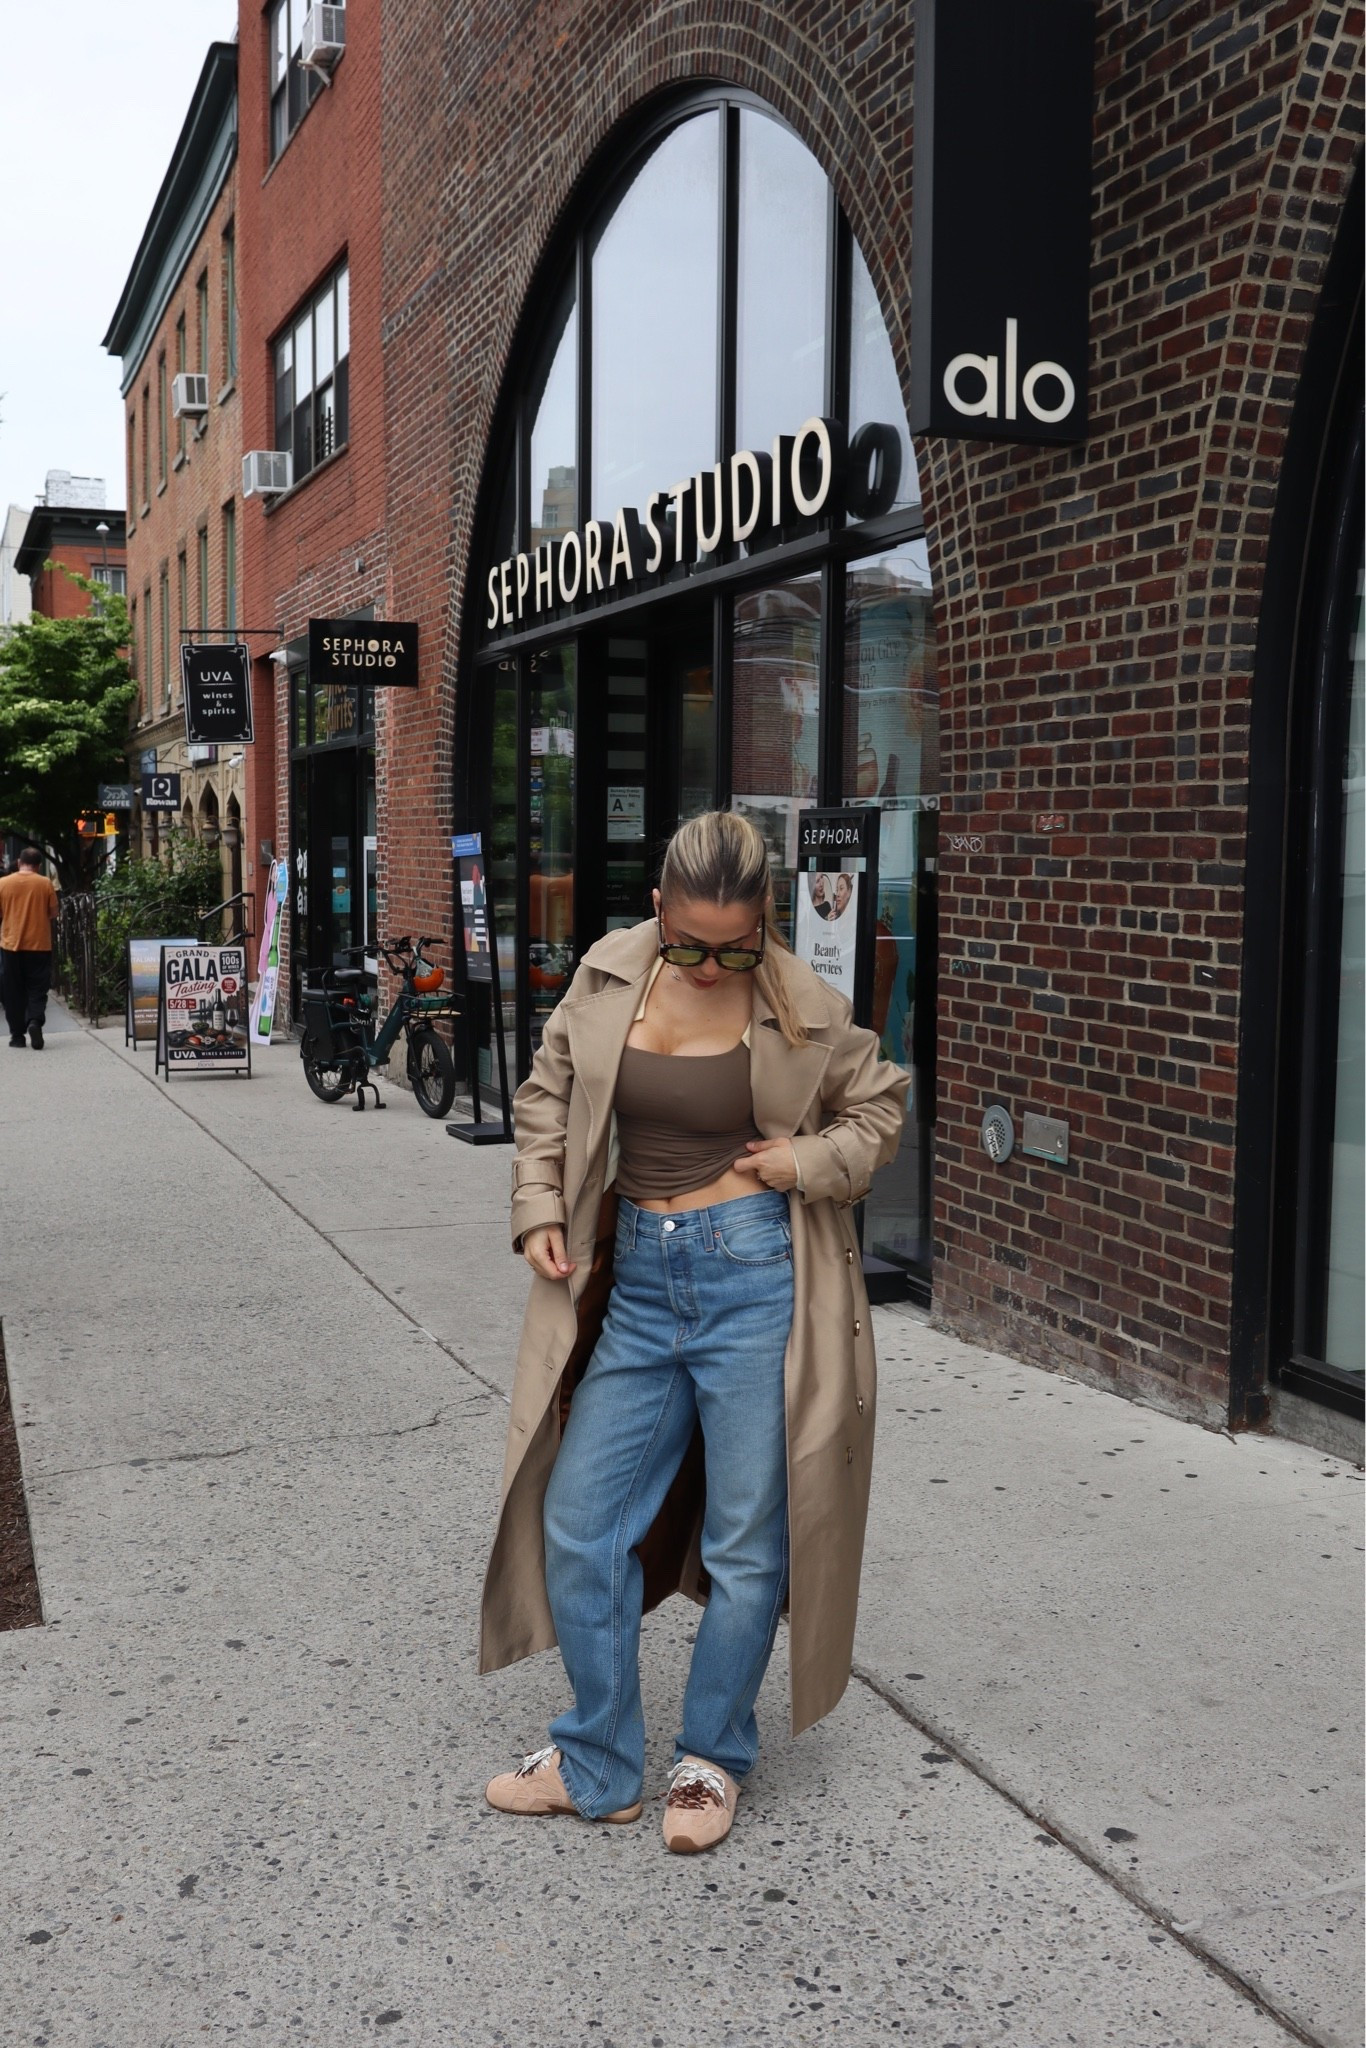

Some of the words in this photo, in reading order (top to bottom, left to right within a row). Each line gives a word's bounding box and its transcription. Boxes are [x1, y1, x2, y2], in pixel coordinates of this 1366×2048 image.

[943, 317, 1075, 423] alo
[487, 507, 634, 630] SEPHORA
[646, 417, 832, 573] STUDIO
[323, 638, 405, 653] SEPHORA
[332, 653, 396, 668] STUDIO
[200, 671, 233, 682] UVA
[202, 707, 236, 717] spirits
[146, 798, 177, 806] Rowan
[612, 798, 624, 812] A
[804, 828, 860, 845] SEPHORA
[175, 949, 210, 958] GRAND
[814, 942, 842, 961] Beauty
[221, 956, 240, 965] 100s
[811, 959, 843, 976] Services
[166, 958, 219, 984] GALA
[170, 981, 217, 997] Tasting
[169, 1000, 187, 1009] 5/28
[173, 1050, 197, 1059] UVA
